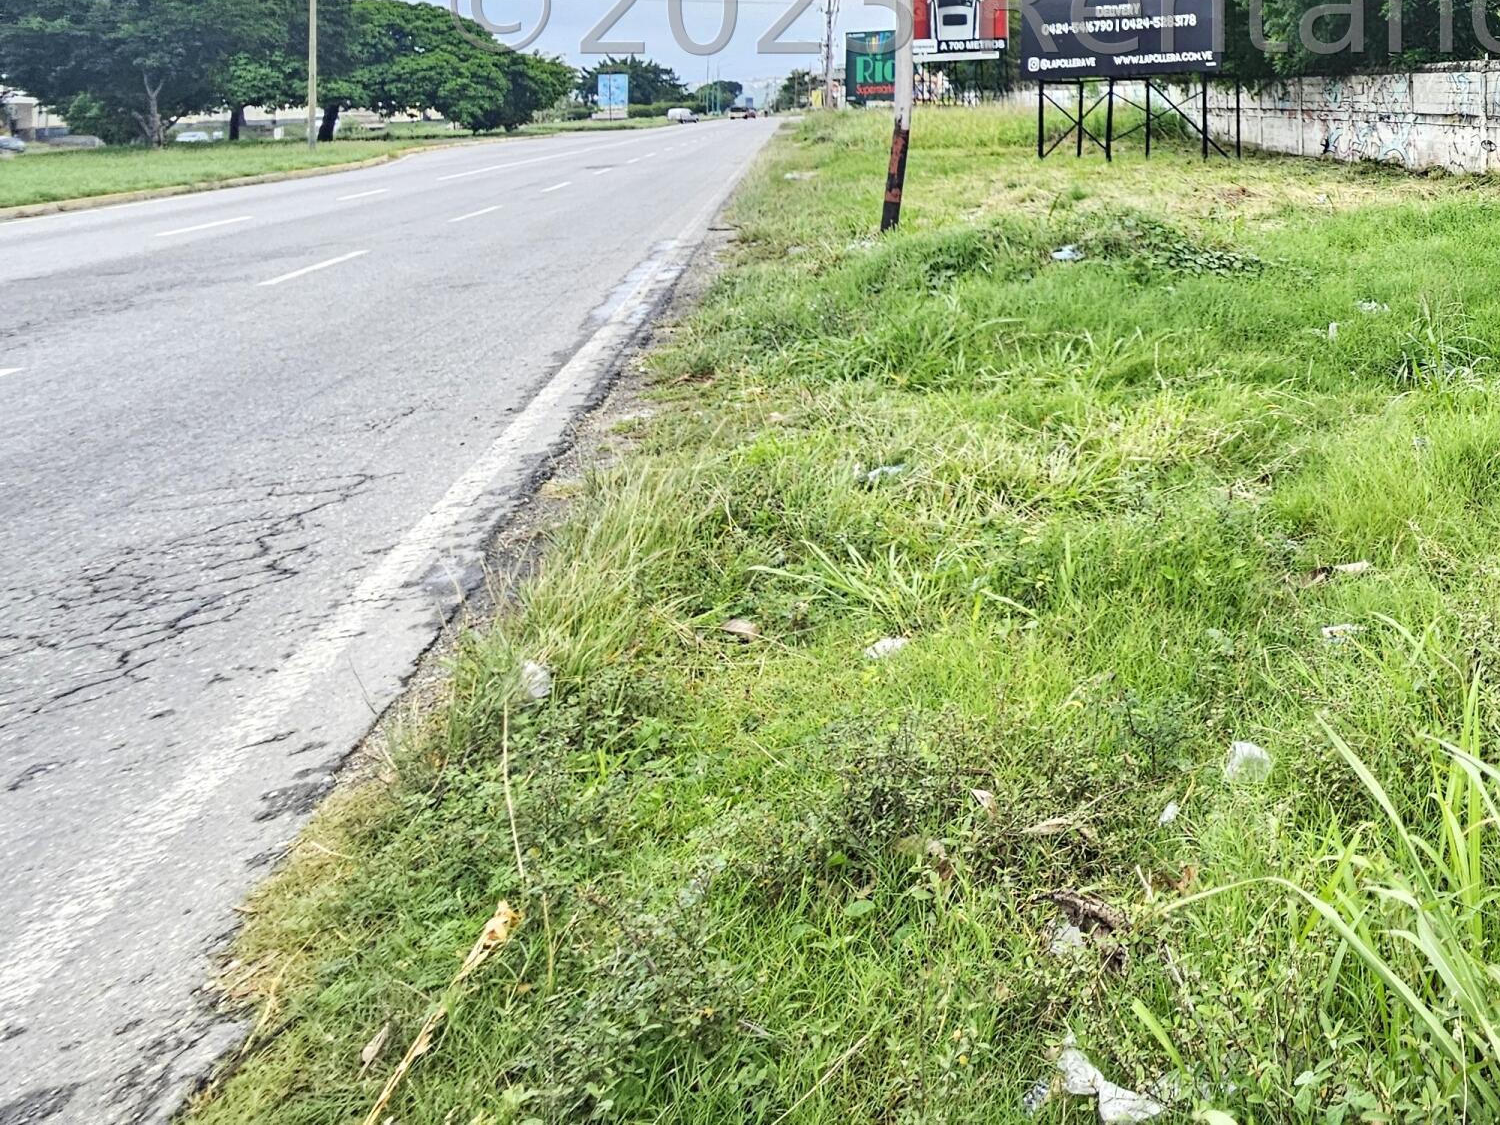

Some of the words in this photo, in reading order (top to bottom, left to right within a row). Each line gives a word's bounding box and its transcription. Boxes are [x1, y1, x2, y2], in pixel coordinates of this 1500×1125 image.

[1095, 2, 1141, 17] DELIVERY
[940, 43, 948, 51] A
[948, 42, 965, 51] 700
